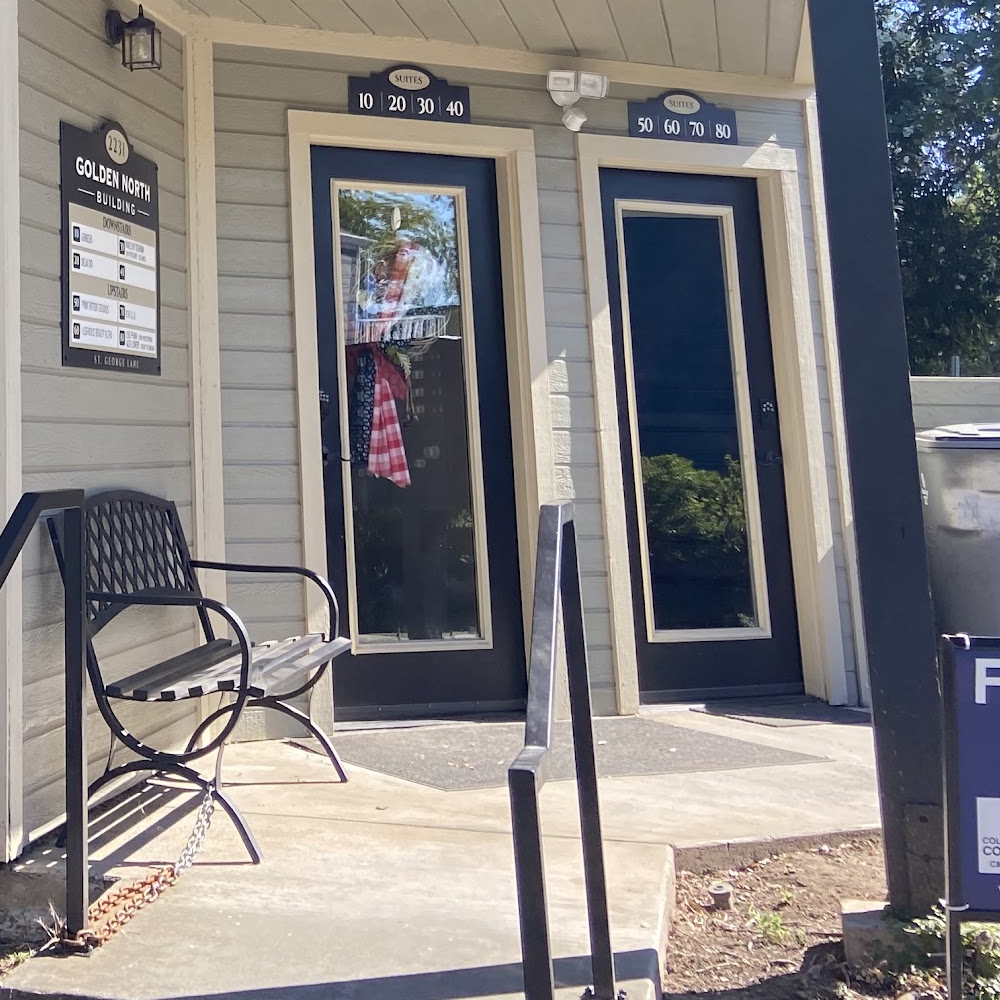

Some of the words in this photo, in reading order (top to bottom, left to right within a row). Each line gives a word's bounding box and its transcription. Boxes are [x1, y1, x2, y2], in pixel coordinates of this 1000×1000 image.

[394, 74, 423, 85] SUITES
[359, 92, 374, 109] 10
[387, 95, 406, 112] 20
[416, 97, 435, 114] 30
[446, 100, 464, 117] 40
[668, 99, 694, 109] SUITES
[638, 117, 653, 133] 50
[664, 119, 680, 135] 60
[689, 121, 704, 137] 70
[715, 123, 731, 139] 80
[108, 135, 126, 157] 2231
[75, 156, 119, 190] GOLDEN
[121, 173, 151, 203] NORTH
[96, 190, 136, 216] BUILDING
[107, 283, 129, 300] UPSTAIRS
